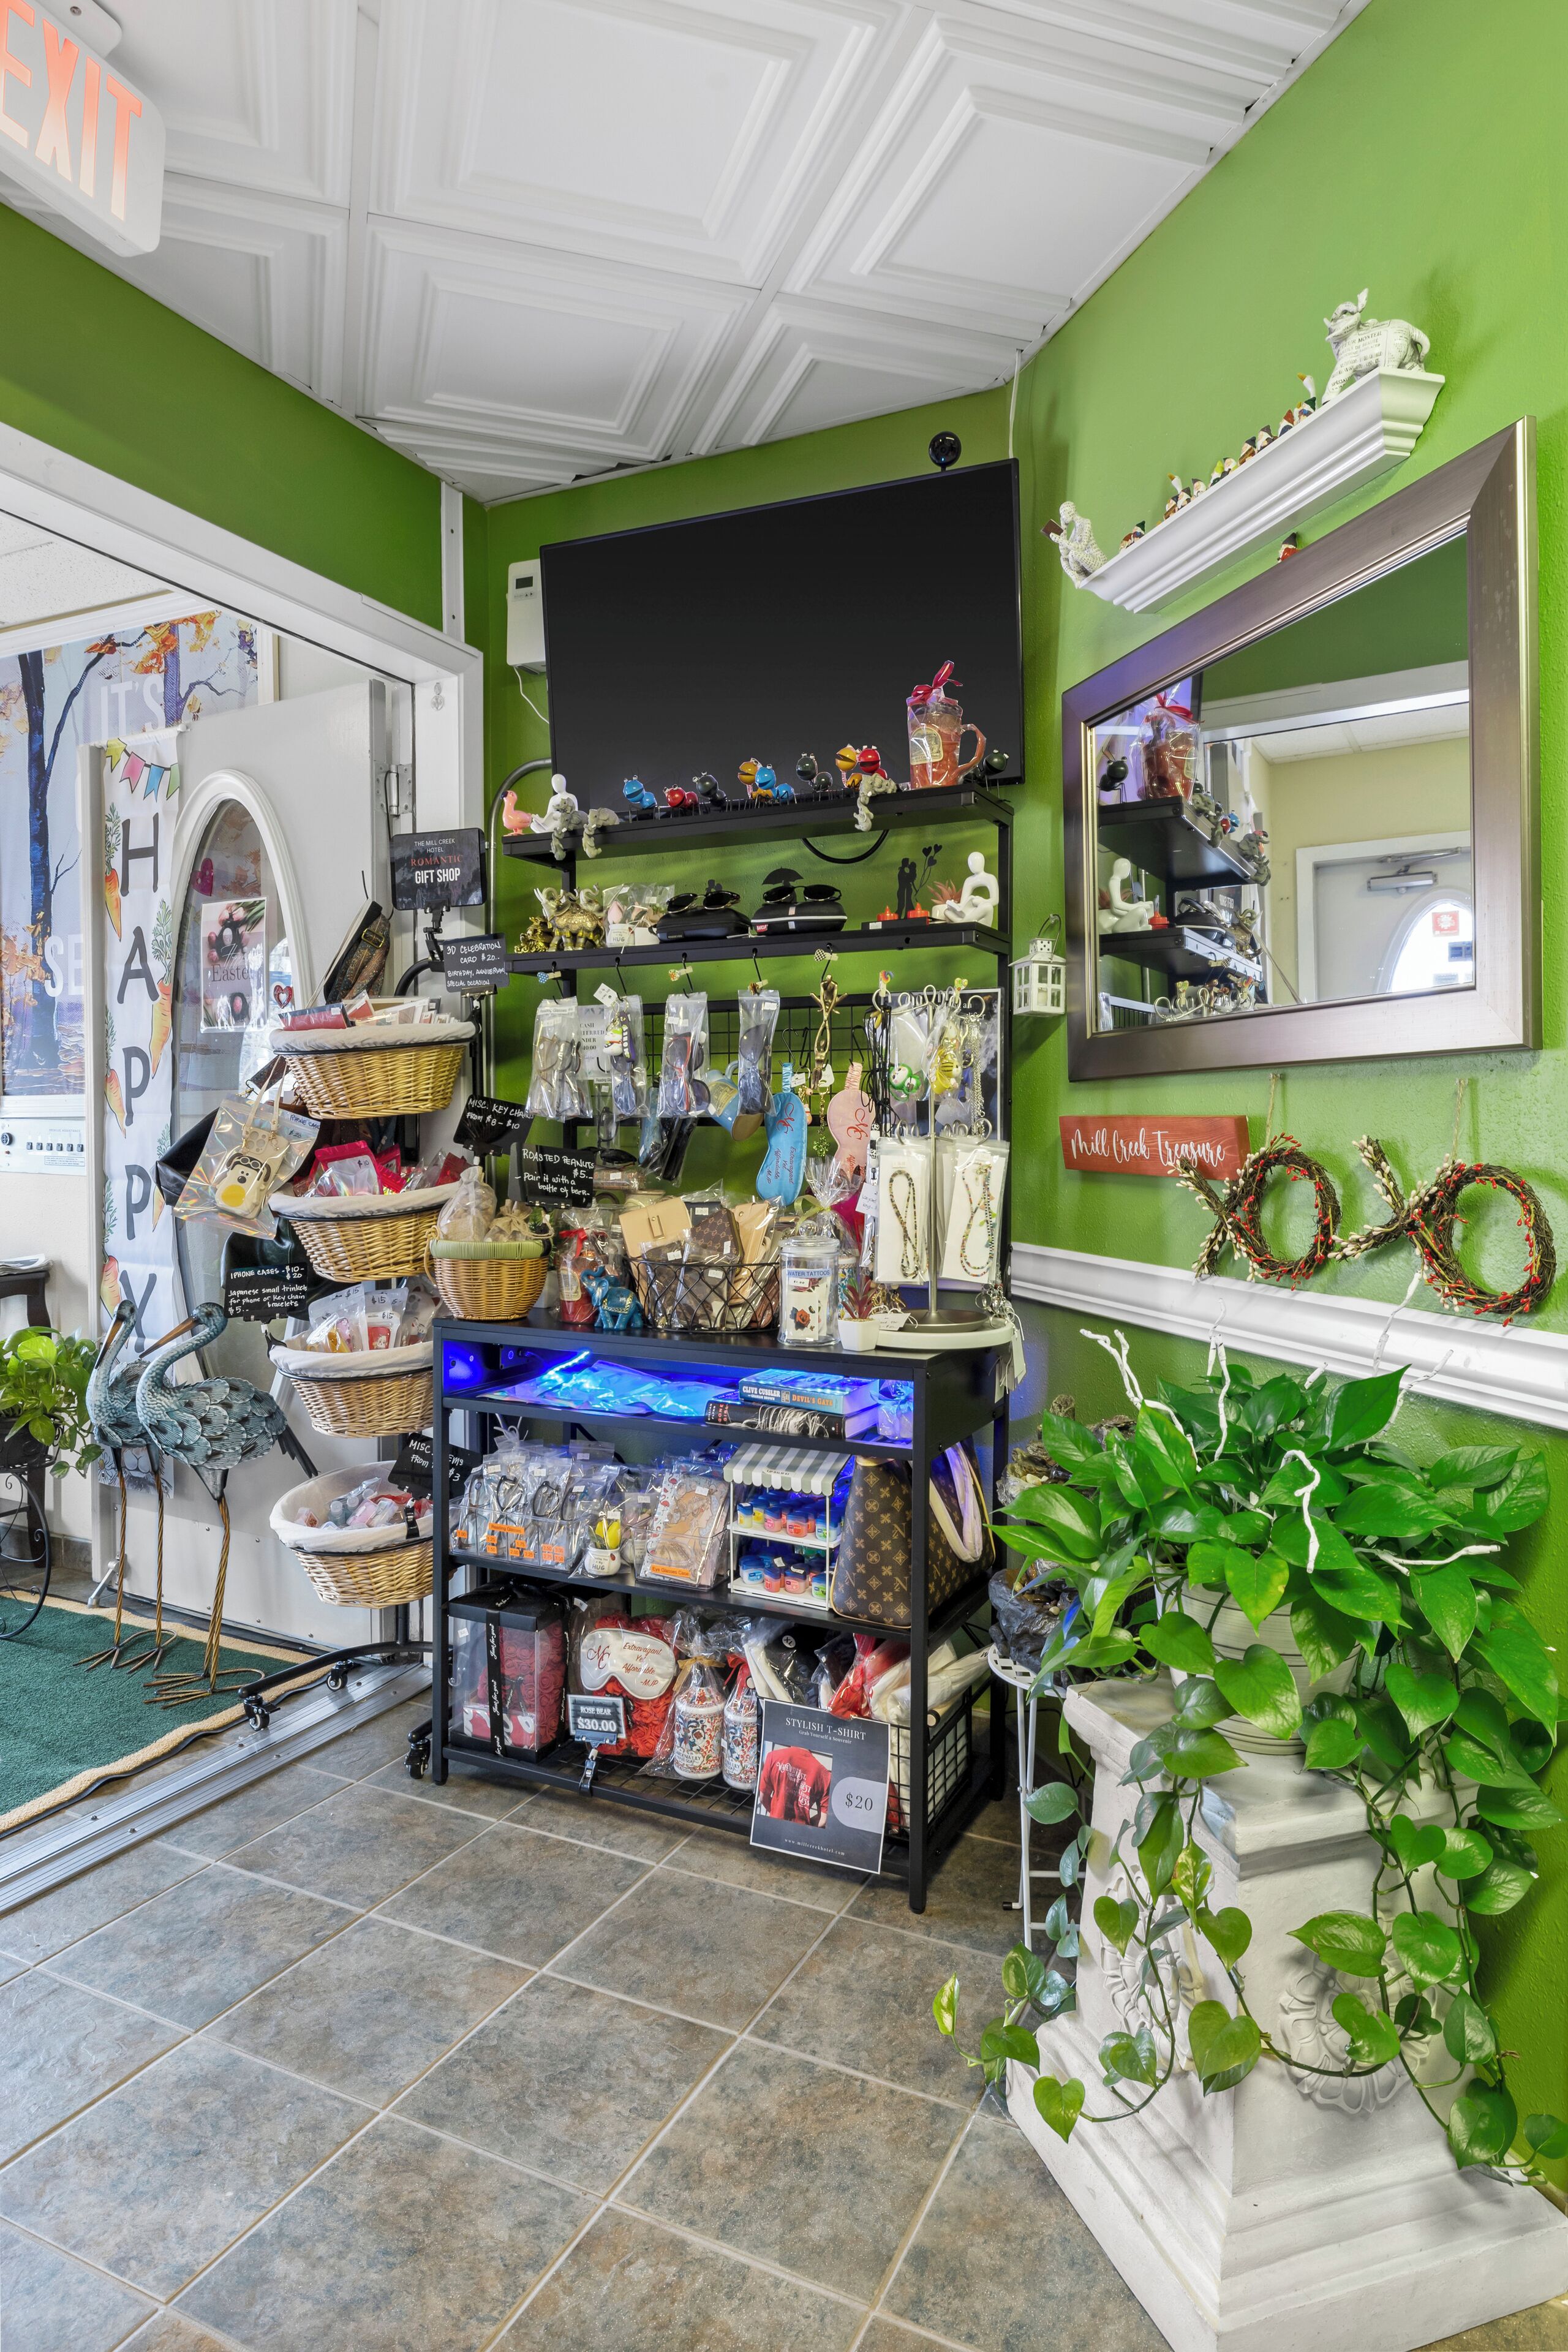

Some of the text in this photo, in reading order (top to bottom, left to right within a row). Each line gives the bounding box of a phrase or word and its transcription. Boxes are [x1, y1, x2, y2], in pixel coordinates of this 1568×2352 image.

[0, 0, 142, 222] EXIT
[411, 854, 463, 867] ROMANTIC
[415, 868, 461, 884] GIFT SHOP
[447, 941, 502, 955] 3D CELEBRATION
[468, 1098, 488, 1109] MISC.
[492, 1104, 508, 1115] KEY
[467, 1112, 483, 1122] FROM
[1071, 1128, 1225, 1167] Mill Creek Treasure
[357, 1159, 369, 1169] $10
[522, 1148, 594, 1169] ROASTED PEANUTS
[543, 1174, 549, 1183] it
[552, 1174, 569, 1184] with
[538, 1182, 557, 1193] bottle
[560, 1186, 568, 1198] of
[230, 1270, 255, 1279] IPHONE
[228, 1289, 258, 1297] Japanese
[345, 1286, 361, 1299] $15
[371, 1295, 386, 1305] $15
[742, 1385, 758, 1395] CLIVE
[758, 1387, 780, 1398] CUSSLER
[792, 1394, 815, 1404] DEVIL'S
[817, 1398, 833, 1406] GATE
[409, 1439, 434, 1455] MISC.
[411, 1454, 429, 1468] FROM
[784, 1637, 793, 1646] XL
[623, 1642, 662, 1657] Extravagant
[596, 1707, 611, 1716] BEAR
[577, 1717, 617, 1732] $30.00
[785, 1717, 865, 1740] STYLISH T-SHIRT
[845, 1792, 873, 1811] $20
[785, 1838, 845, 1856] www.millcreekhotel.com
